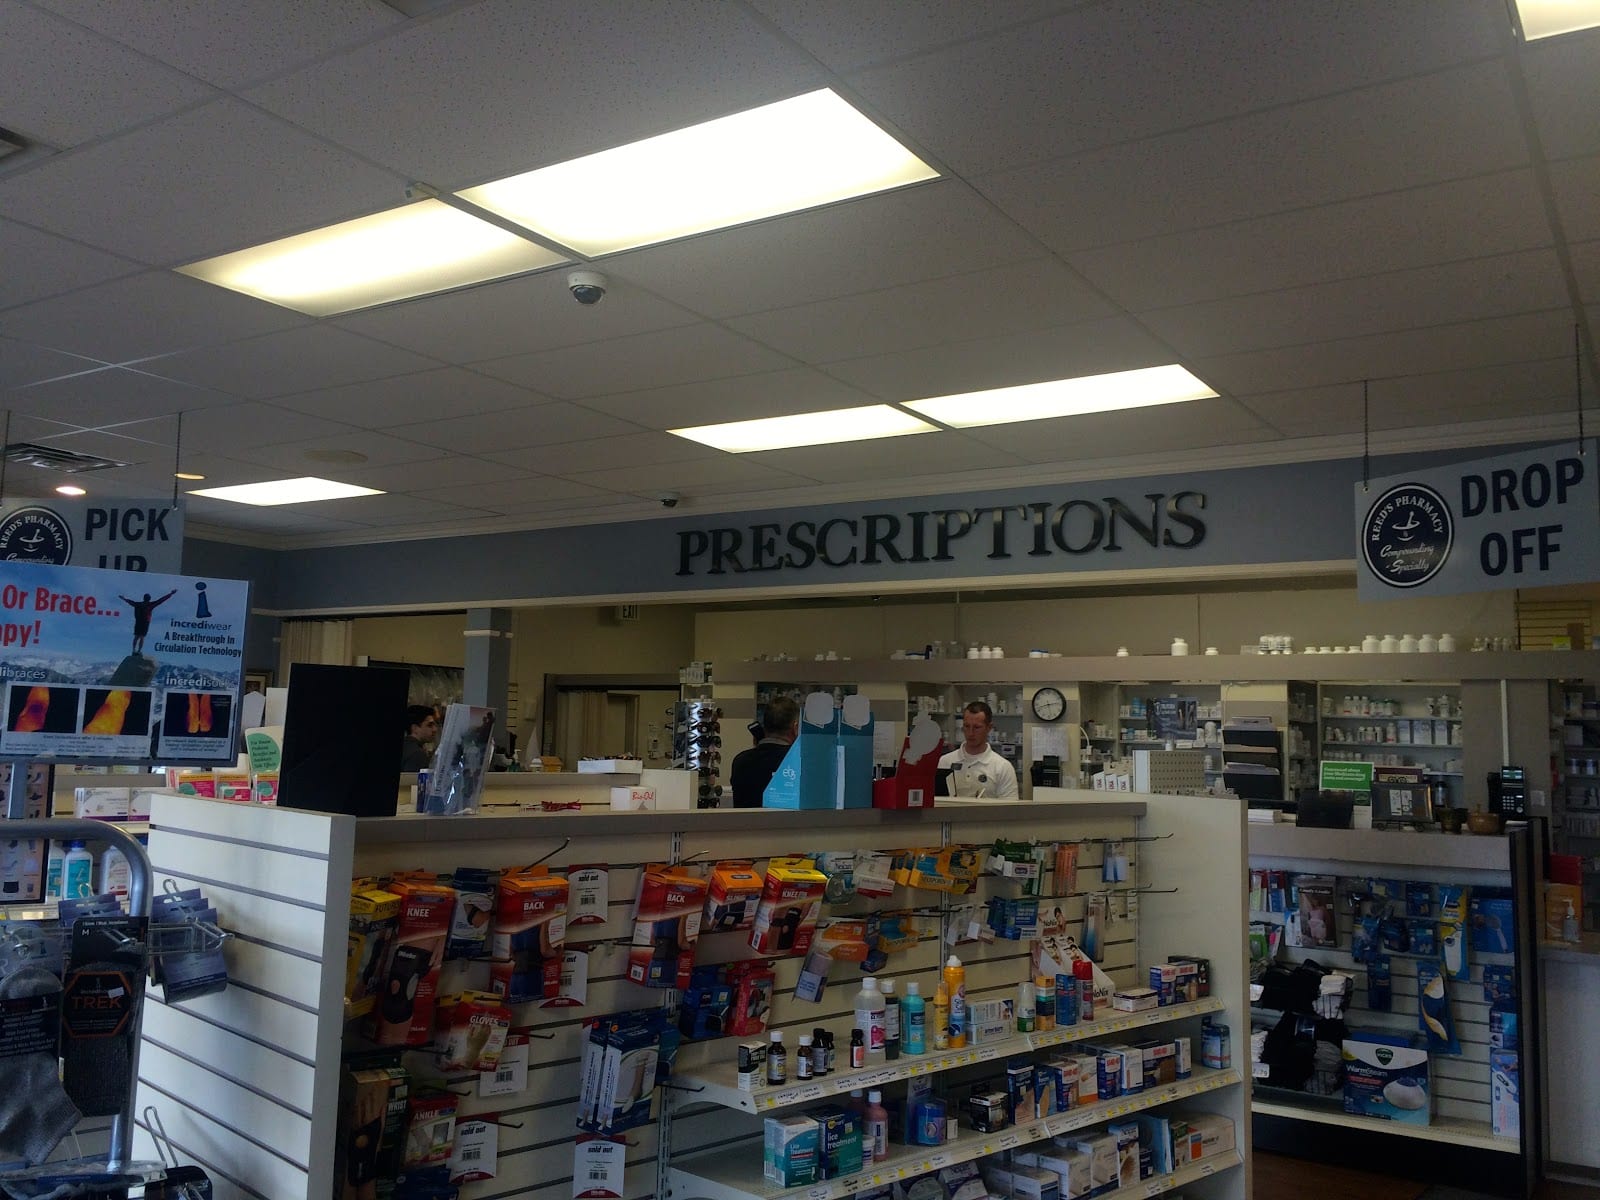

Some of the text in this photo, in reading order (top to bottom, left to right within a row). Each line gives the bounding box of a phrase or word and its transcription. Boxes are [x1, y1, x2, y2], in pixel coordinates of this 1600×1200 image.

[1461, 458, 1584, 518] DROP
[85, 508, 171, 541] PICK
[1371, 495, 1444, 542] REED'S PHARMACY
[0, 515, 64, 550] REED'S PHARMACY
[676, 491, 1206, 576] PRESCRIPTIONS
[1481, 524, 1564, 576] OFF
[3, 584, 120, 617] Or Brace...
[170, 618, 233, 631] incrediwear
[164, 632, 235, 645] A Breakthrough In
[154, 642, 242, 658] Circulation Technology
[666, 894, 685, 904] BACK
[406, 907, 430, 917] KNEE
[523, 901, 545, 911] BACK
[82, 928, 90, 937] M
[72, 996, 122, 1009] TREK
[470, 1015, 499, 1026] GLOVES
[388, 1100, 407, 1112] WRIST
[414, 1109, 440, 1121] ANKLE
[461, 1126, 487, 1136] sold out
[827, 1132, 839, 1140] lice
[827, 1136, 857, 1150] treatment
